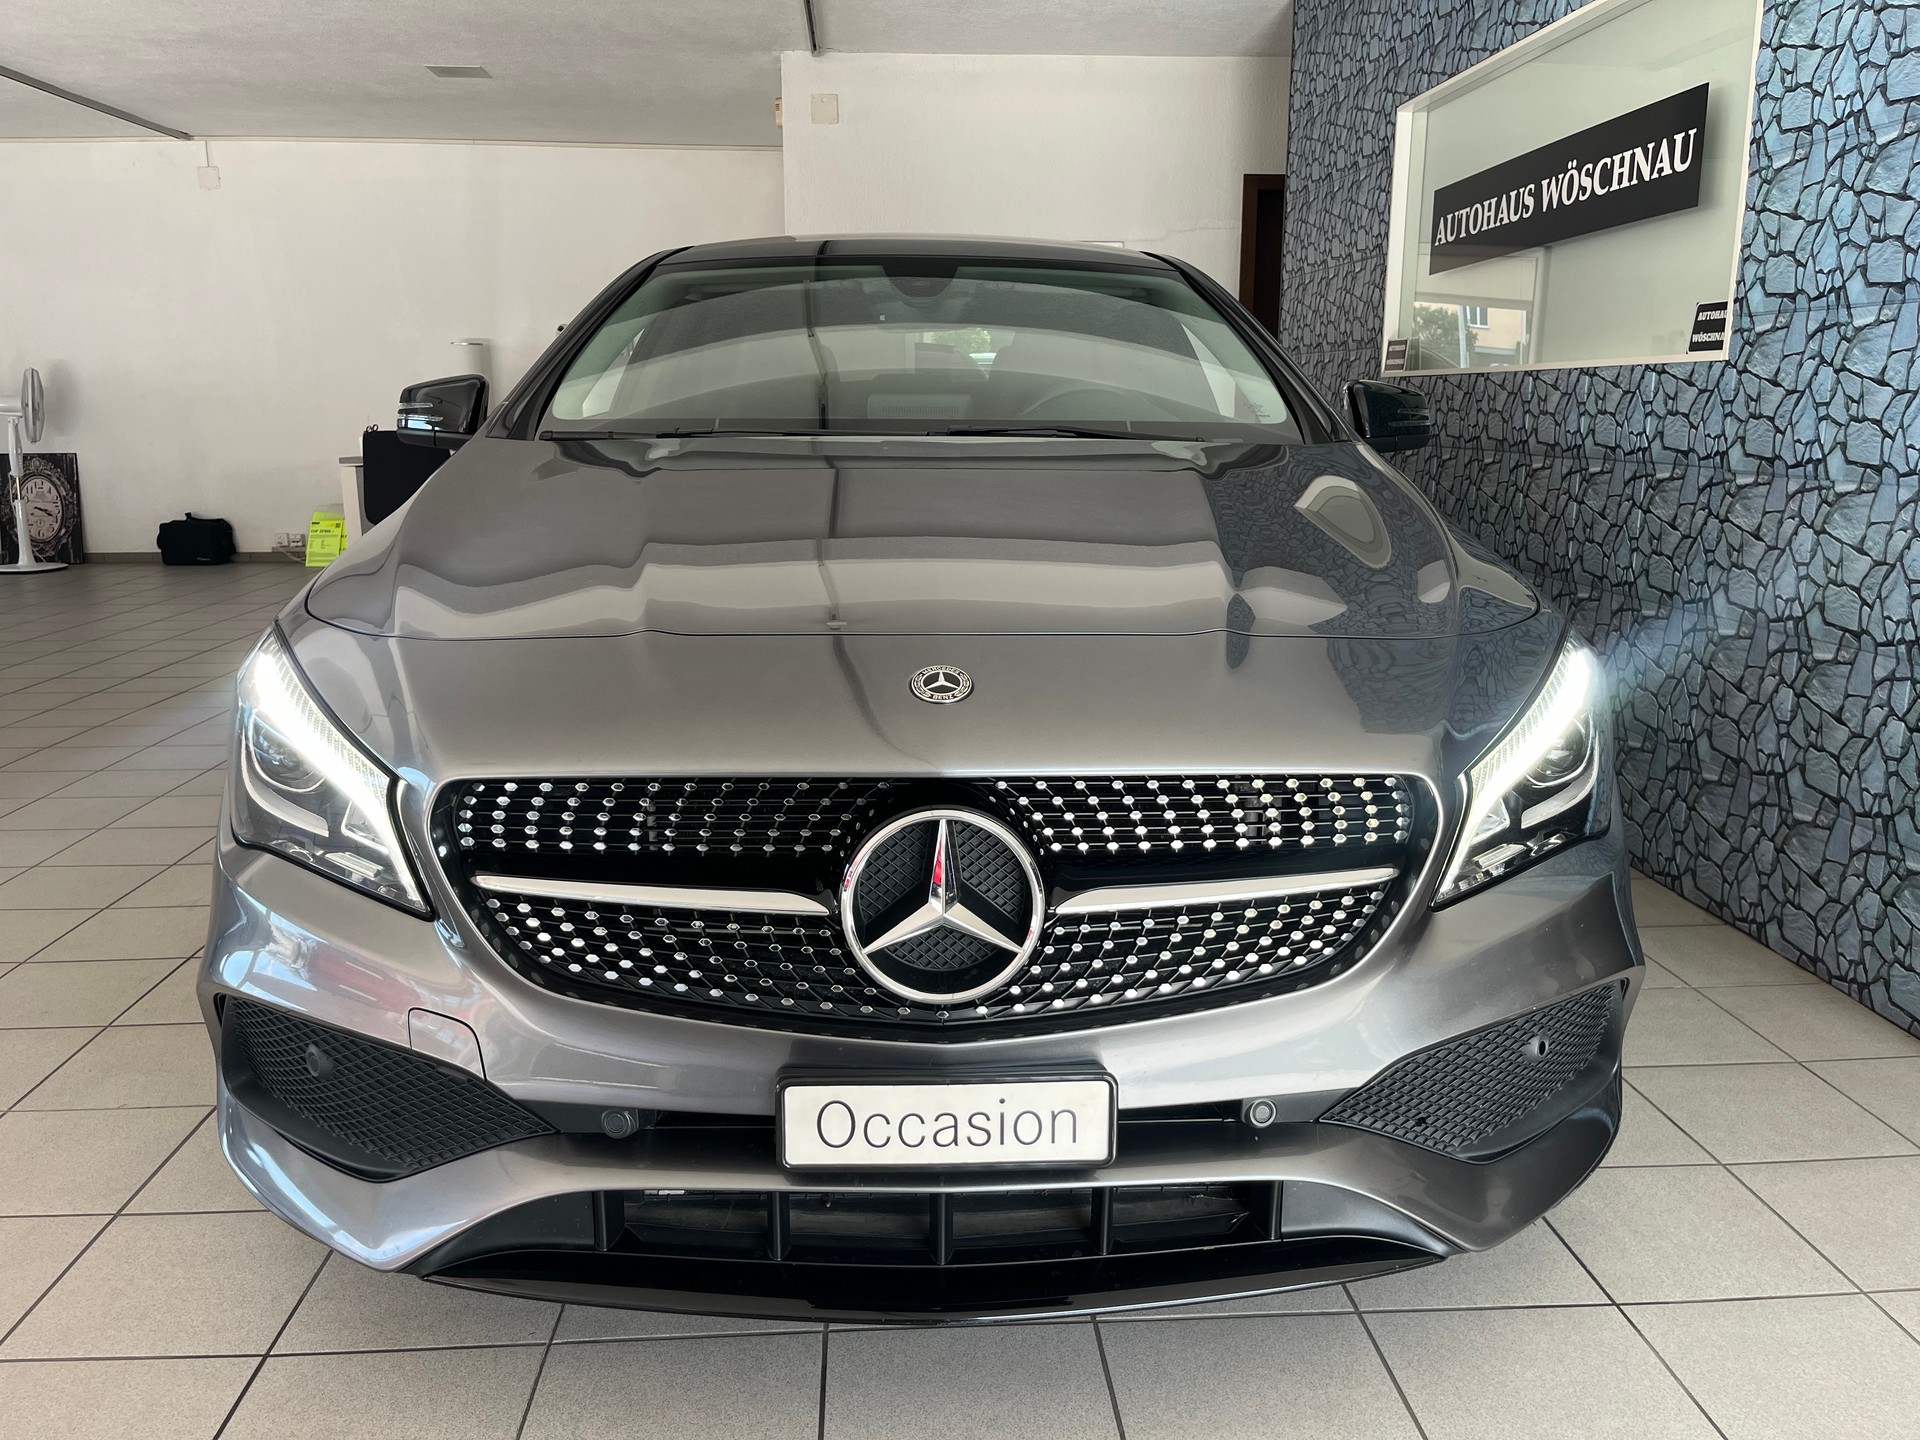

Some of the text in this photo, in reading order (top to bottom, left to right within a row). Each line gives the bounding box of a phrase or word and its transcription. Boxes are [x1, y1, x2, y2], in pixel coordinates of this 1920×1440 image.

[1434, 128, 1697, 246] AUTOHAUS WÖSCHNAU
[816, 1097, 1077, 1149] Occasion
